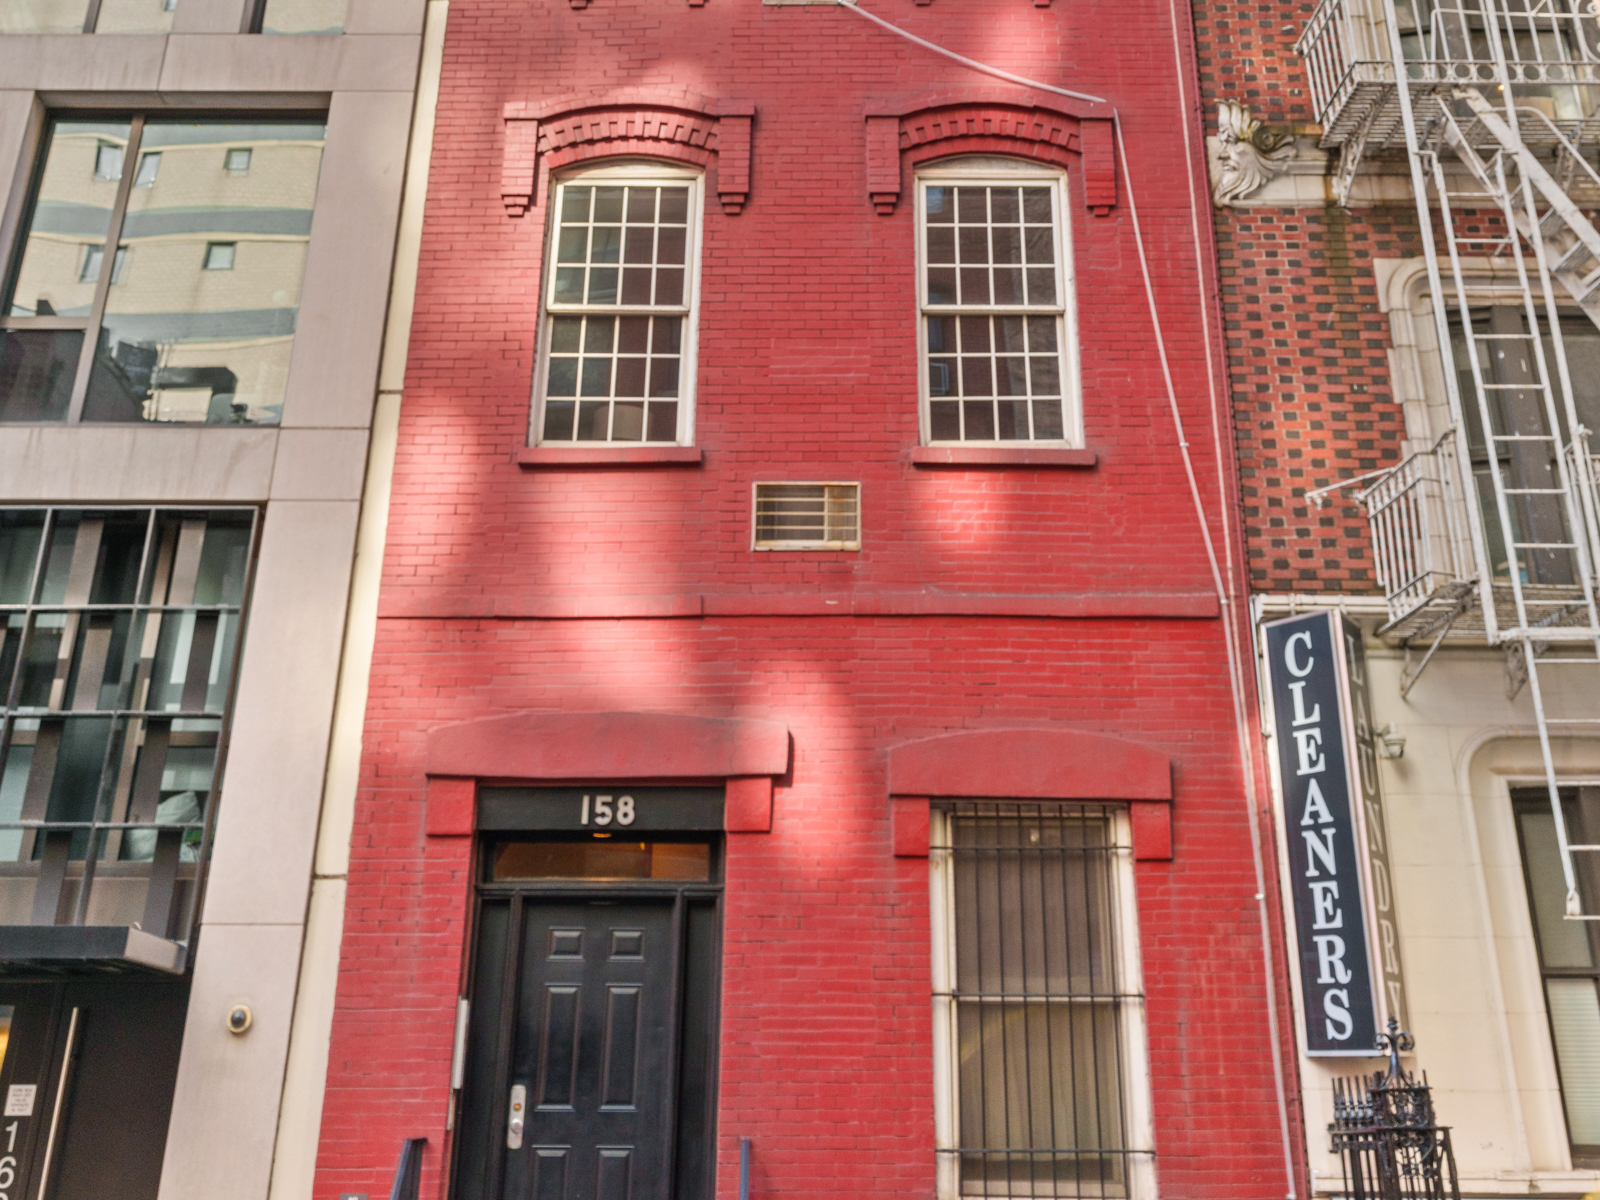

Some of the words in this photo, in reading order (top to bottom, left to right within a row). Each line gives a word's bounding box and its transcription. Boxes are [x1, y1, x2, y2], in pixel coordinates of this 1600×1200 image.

[581, 794, 635, 826] 158
[1284, 630, 1353, 1041] CLEANERS
[1346, 634, 1402, 1031] LAUNDRY
[0, 1120, 18, 1200] 16
